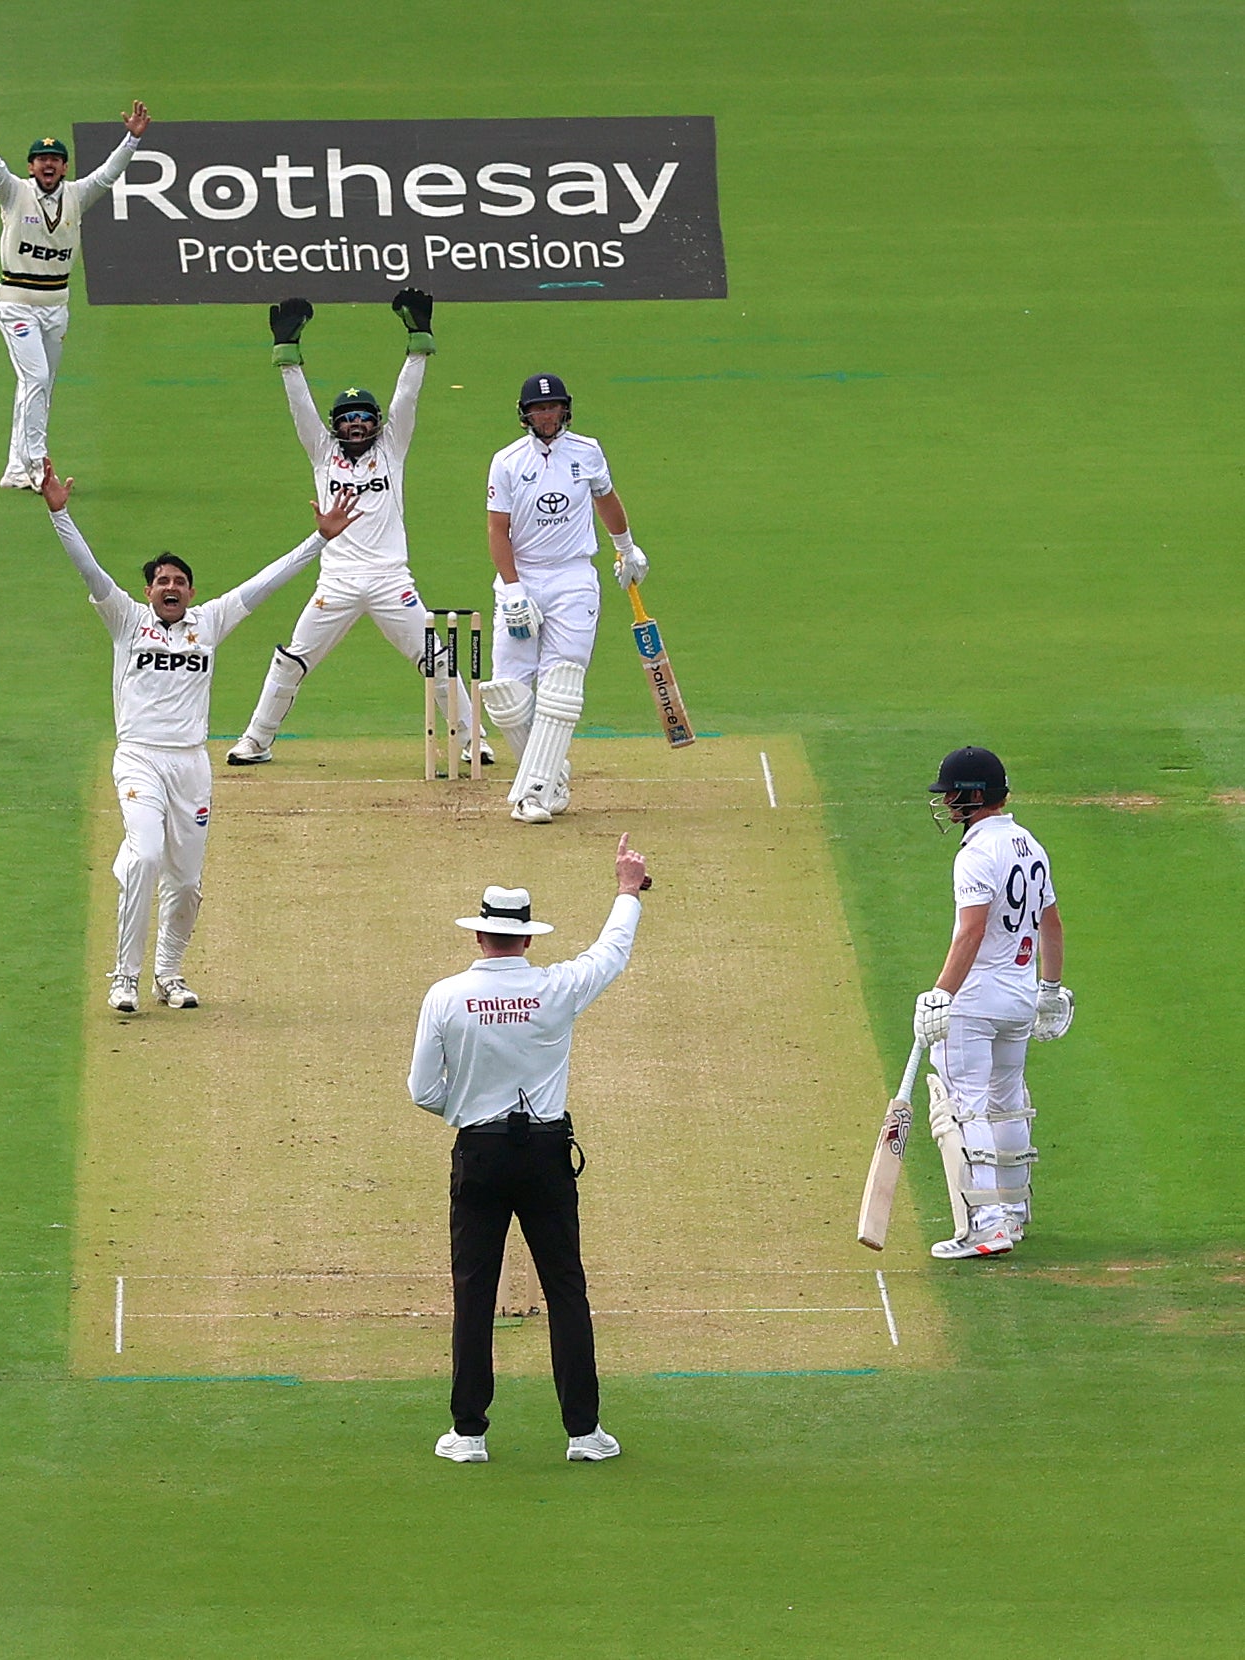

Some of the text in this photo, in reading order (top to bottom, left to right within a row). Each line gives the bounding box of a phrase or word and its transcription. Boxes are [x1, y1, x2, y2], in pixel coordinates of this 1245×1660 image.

[113, 148, 679, 235] Rothesay
[18, 241, 73, 262] PEPSI
[177, 234, 626, 281] Protecting Pensions
[536, 516, 570, 527] TOYOTA
[639, 625, 656, 655] new
[137, 652, 209, 673] PEPSI
[1012, 836, 1033, 858] COX
[1002, 860, 1046, 933] 93
[466, 996, 541, 1013] Emirates
[479, 1011, 531, 1026] FLY BETTER
